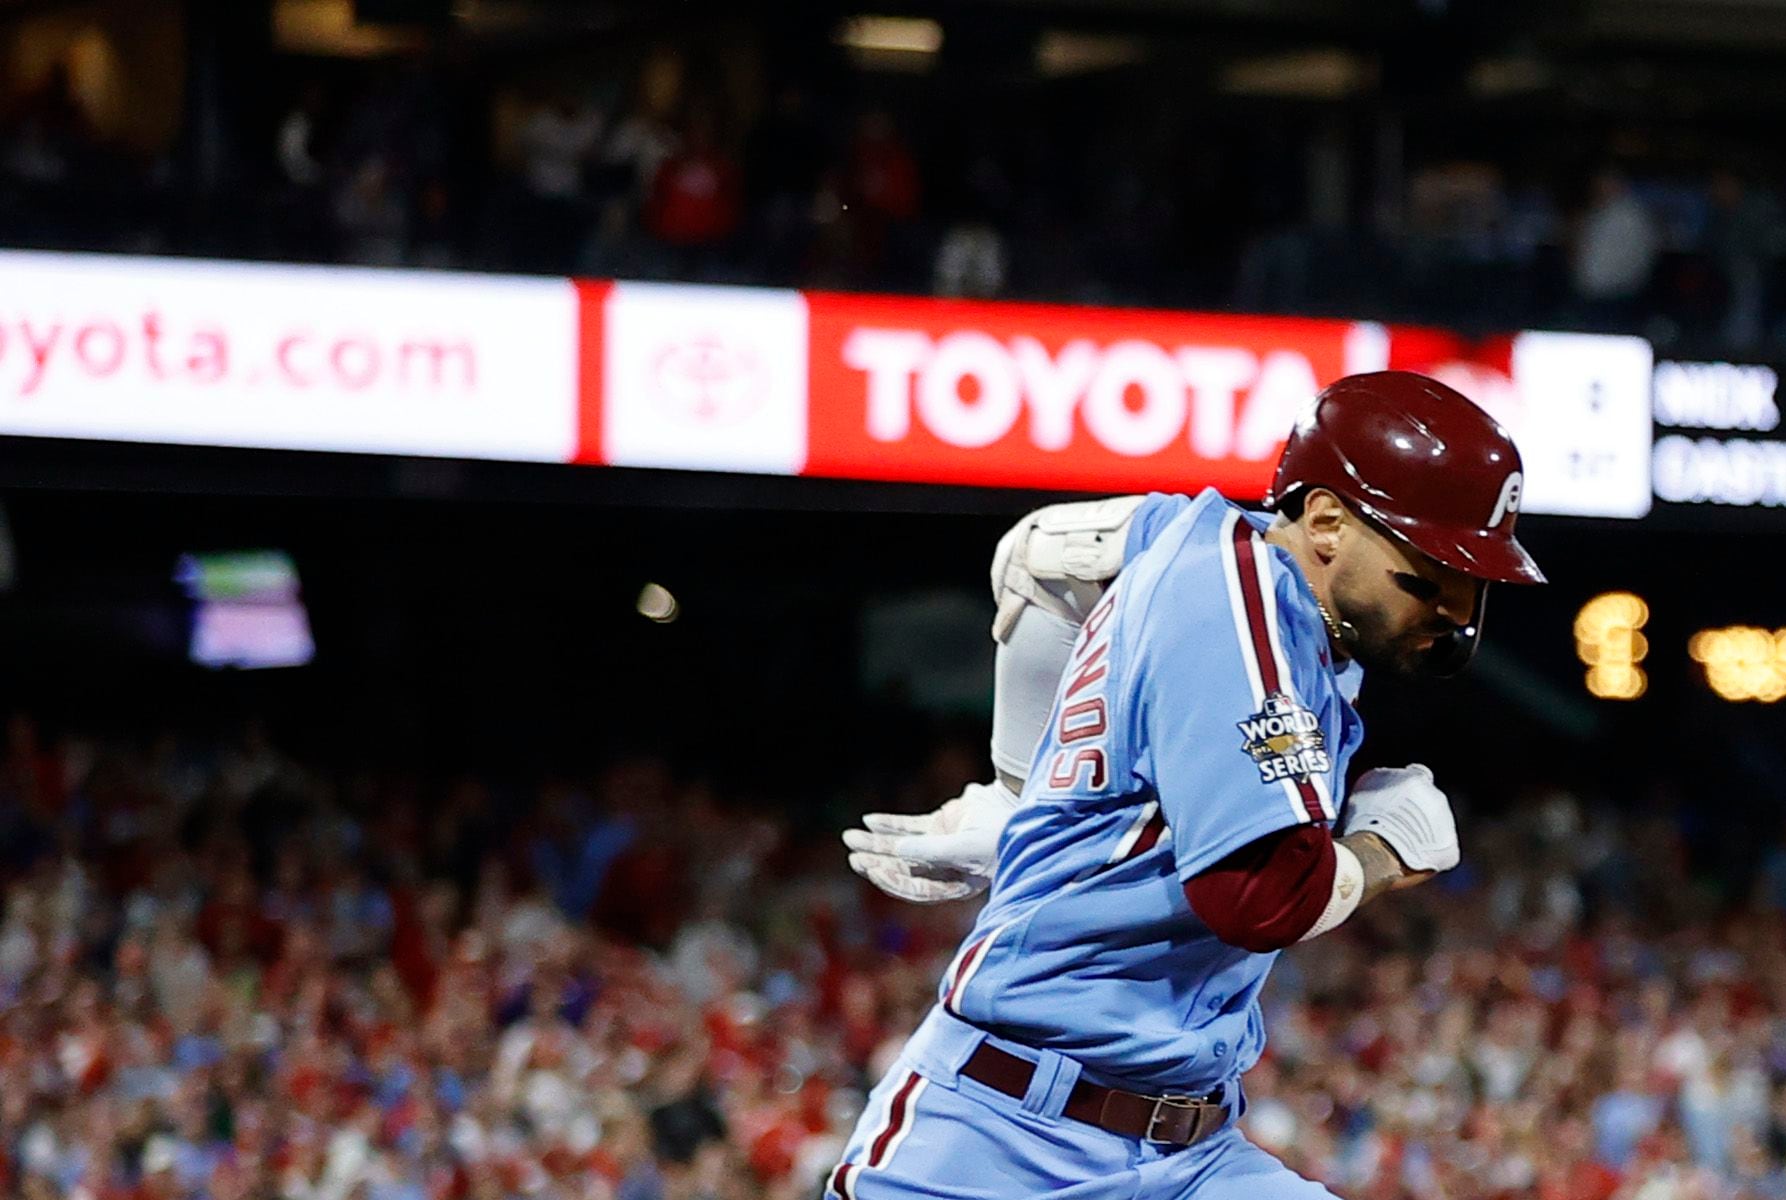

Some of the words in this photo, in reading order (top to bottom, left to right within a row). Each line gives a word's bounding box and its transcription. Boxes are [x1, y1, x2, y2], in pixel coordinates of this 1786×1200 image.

[0, 308, 478, 398] yota.com
[842, 326, 1320, 462] TOYOTA
[1238, 710, 1319, 741] WORLD
[1258, 750, 1330, 782] SERIES
